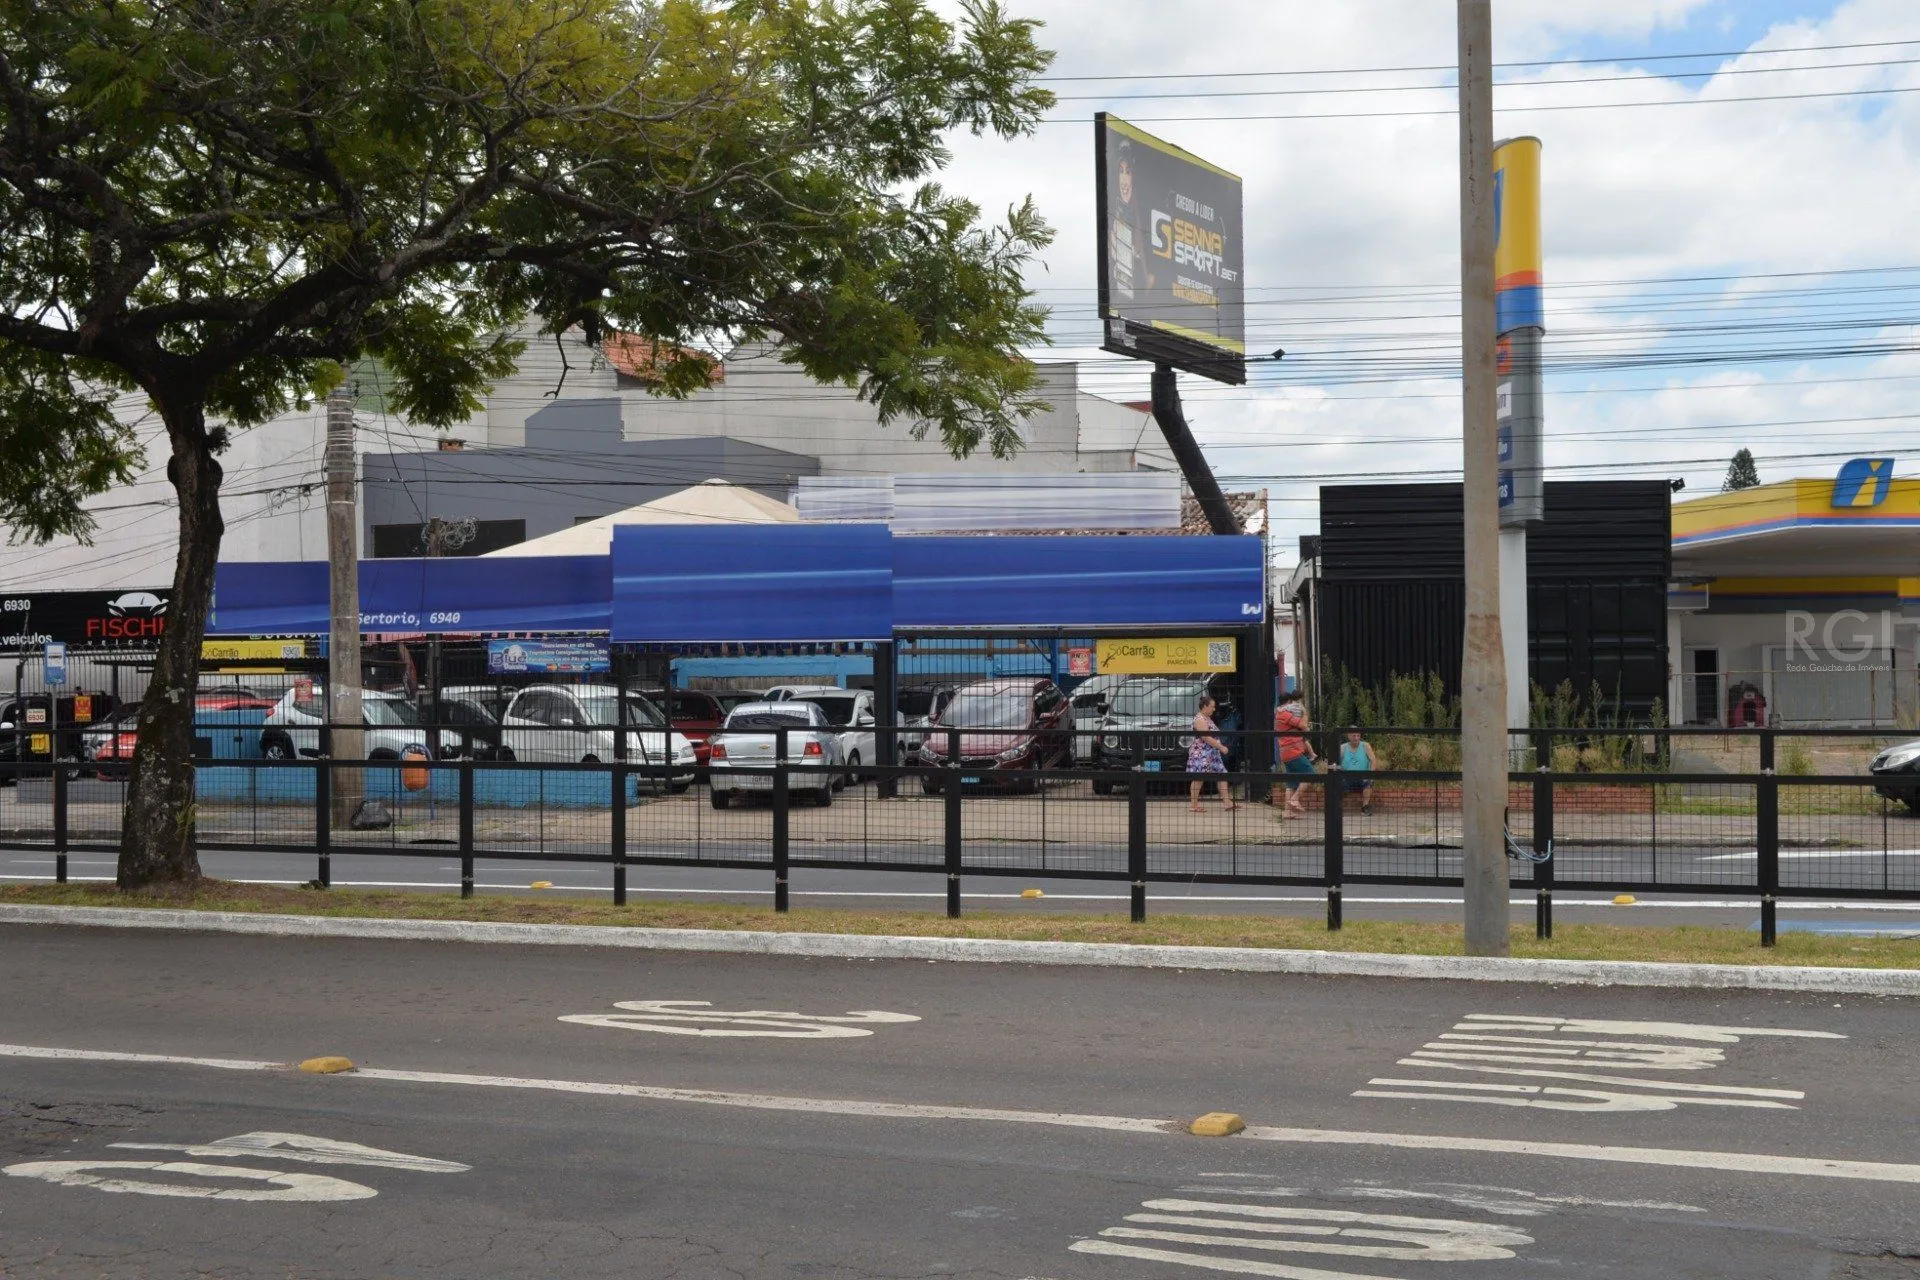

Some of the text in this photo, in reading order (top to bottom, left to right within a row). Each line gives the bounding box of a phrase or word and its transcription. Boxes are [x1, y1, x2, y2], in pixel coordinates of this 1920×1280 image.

[1173, 218, 1224, 257] SENNA
[4, 599, 31, 612] 6930
[429, 612, 461, 625] 6940
[86, 617, 165, 638] FISCH
[1166, 643, 1198, 658] Loja
